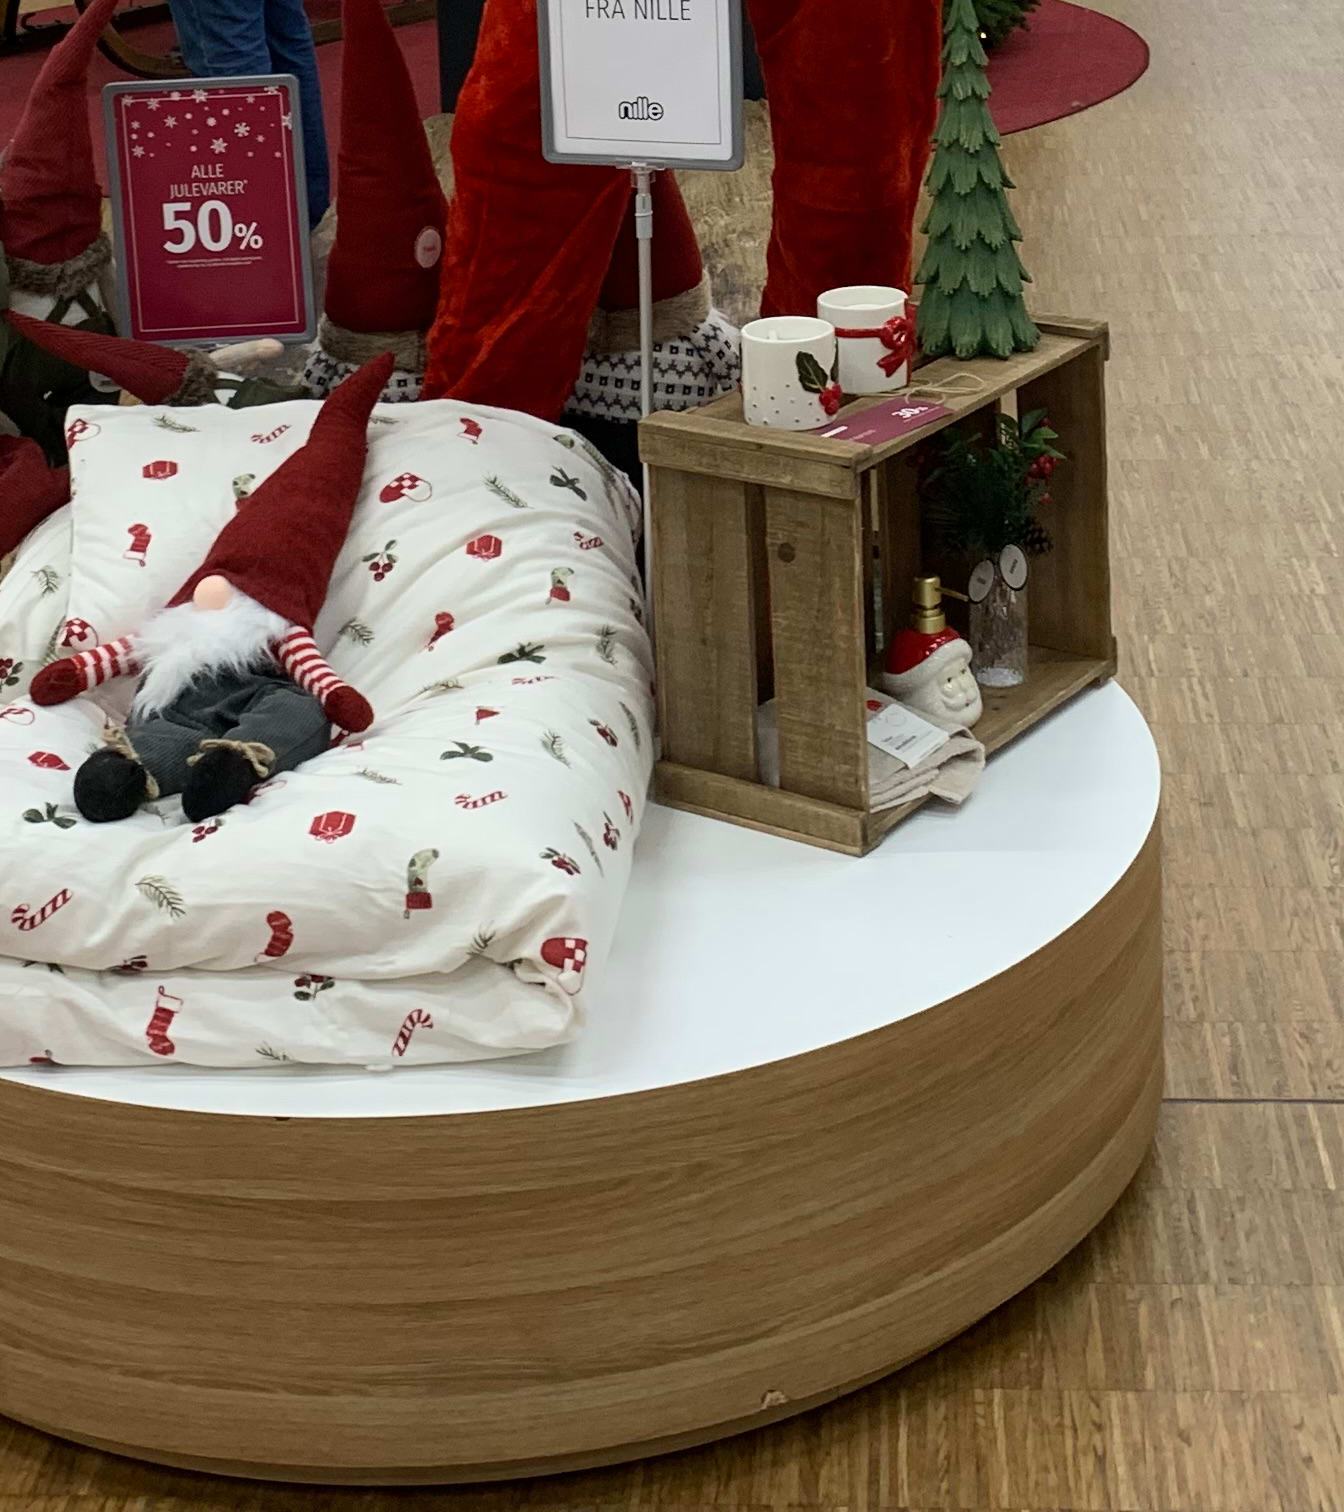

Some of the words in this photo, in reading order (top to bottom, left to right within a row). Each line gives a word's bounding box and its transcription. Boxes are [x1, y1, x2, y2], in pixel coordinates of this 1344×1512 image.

[618, 96, 664, 121] nille
[191, 163, 224, 179] ALLE
[162, 199, 263, 254] 50%
